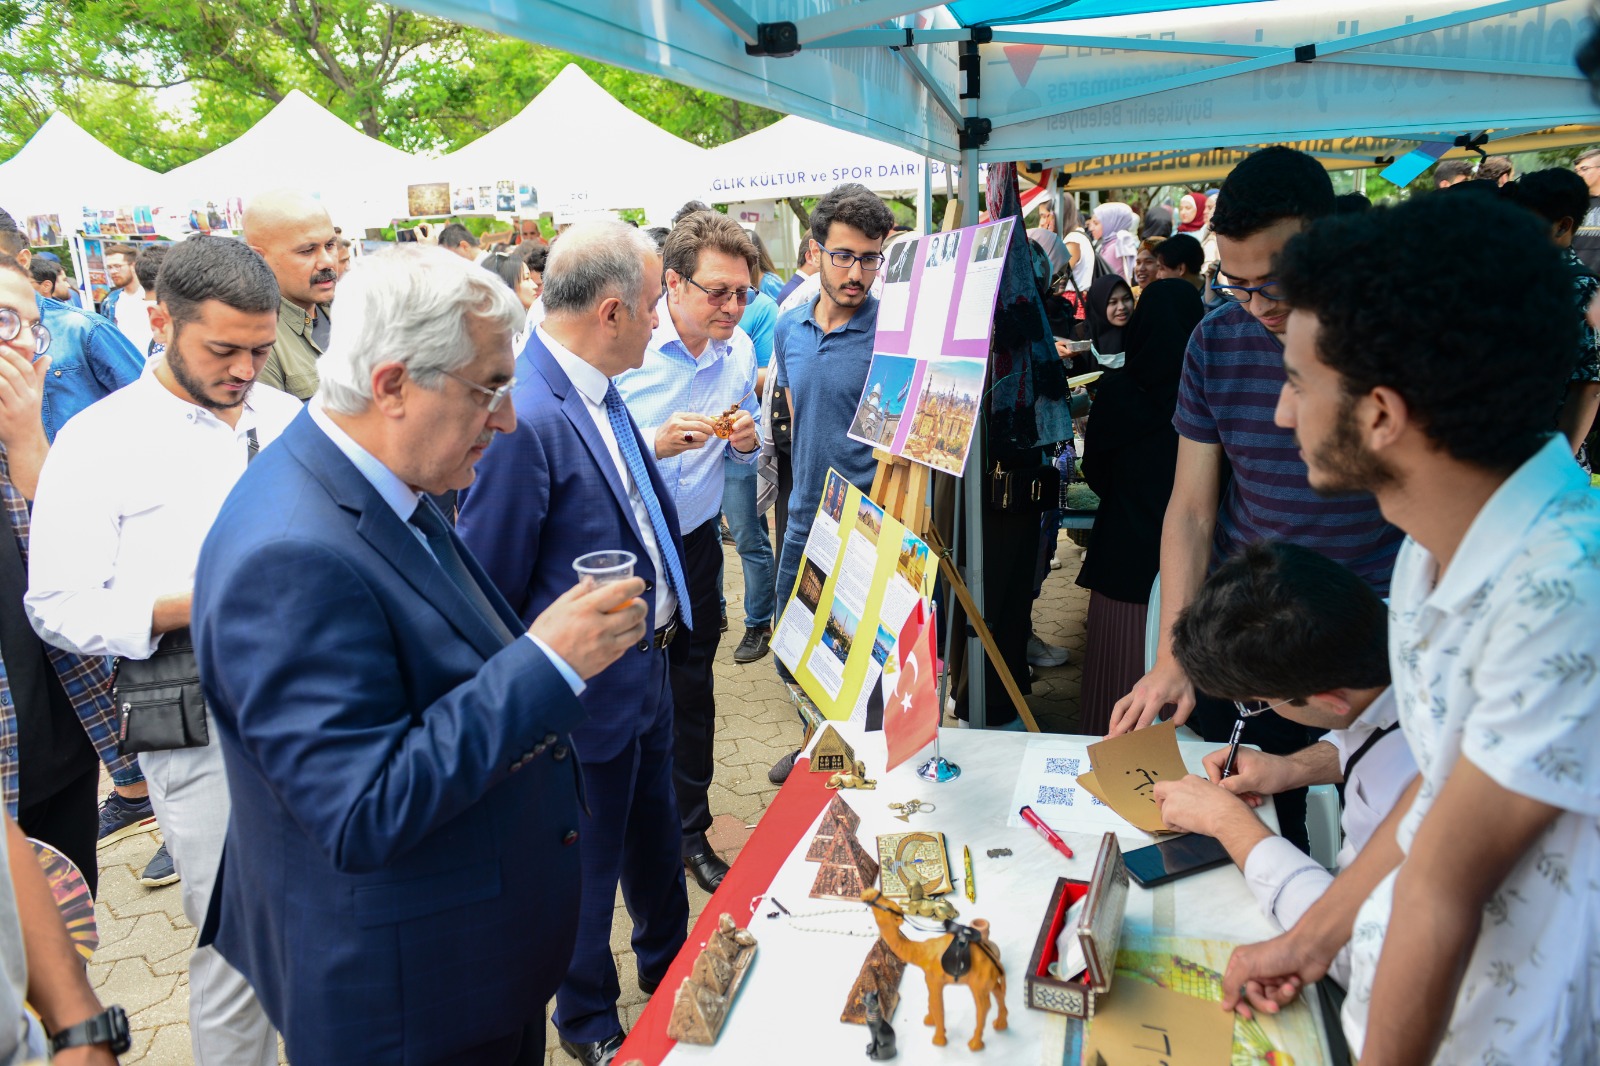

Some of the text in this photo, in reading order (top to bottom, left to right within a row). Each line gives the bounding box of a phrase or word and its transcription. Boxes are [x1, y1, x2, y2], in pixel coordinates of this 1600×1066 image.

[811, 172, 827, 182] ve
[832, 166, 872, 181] SPOR
[878, 160, 920, 177] DAİR
